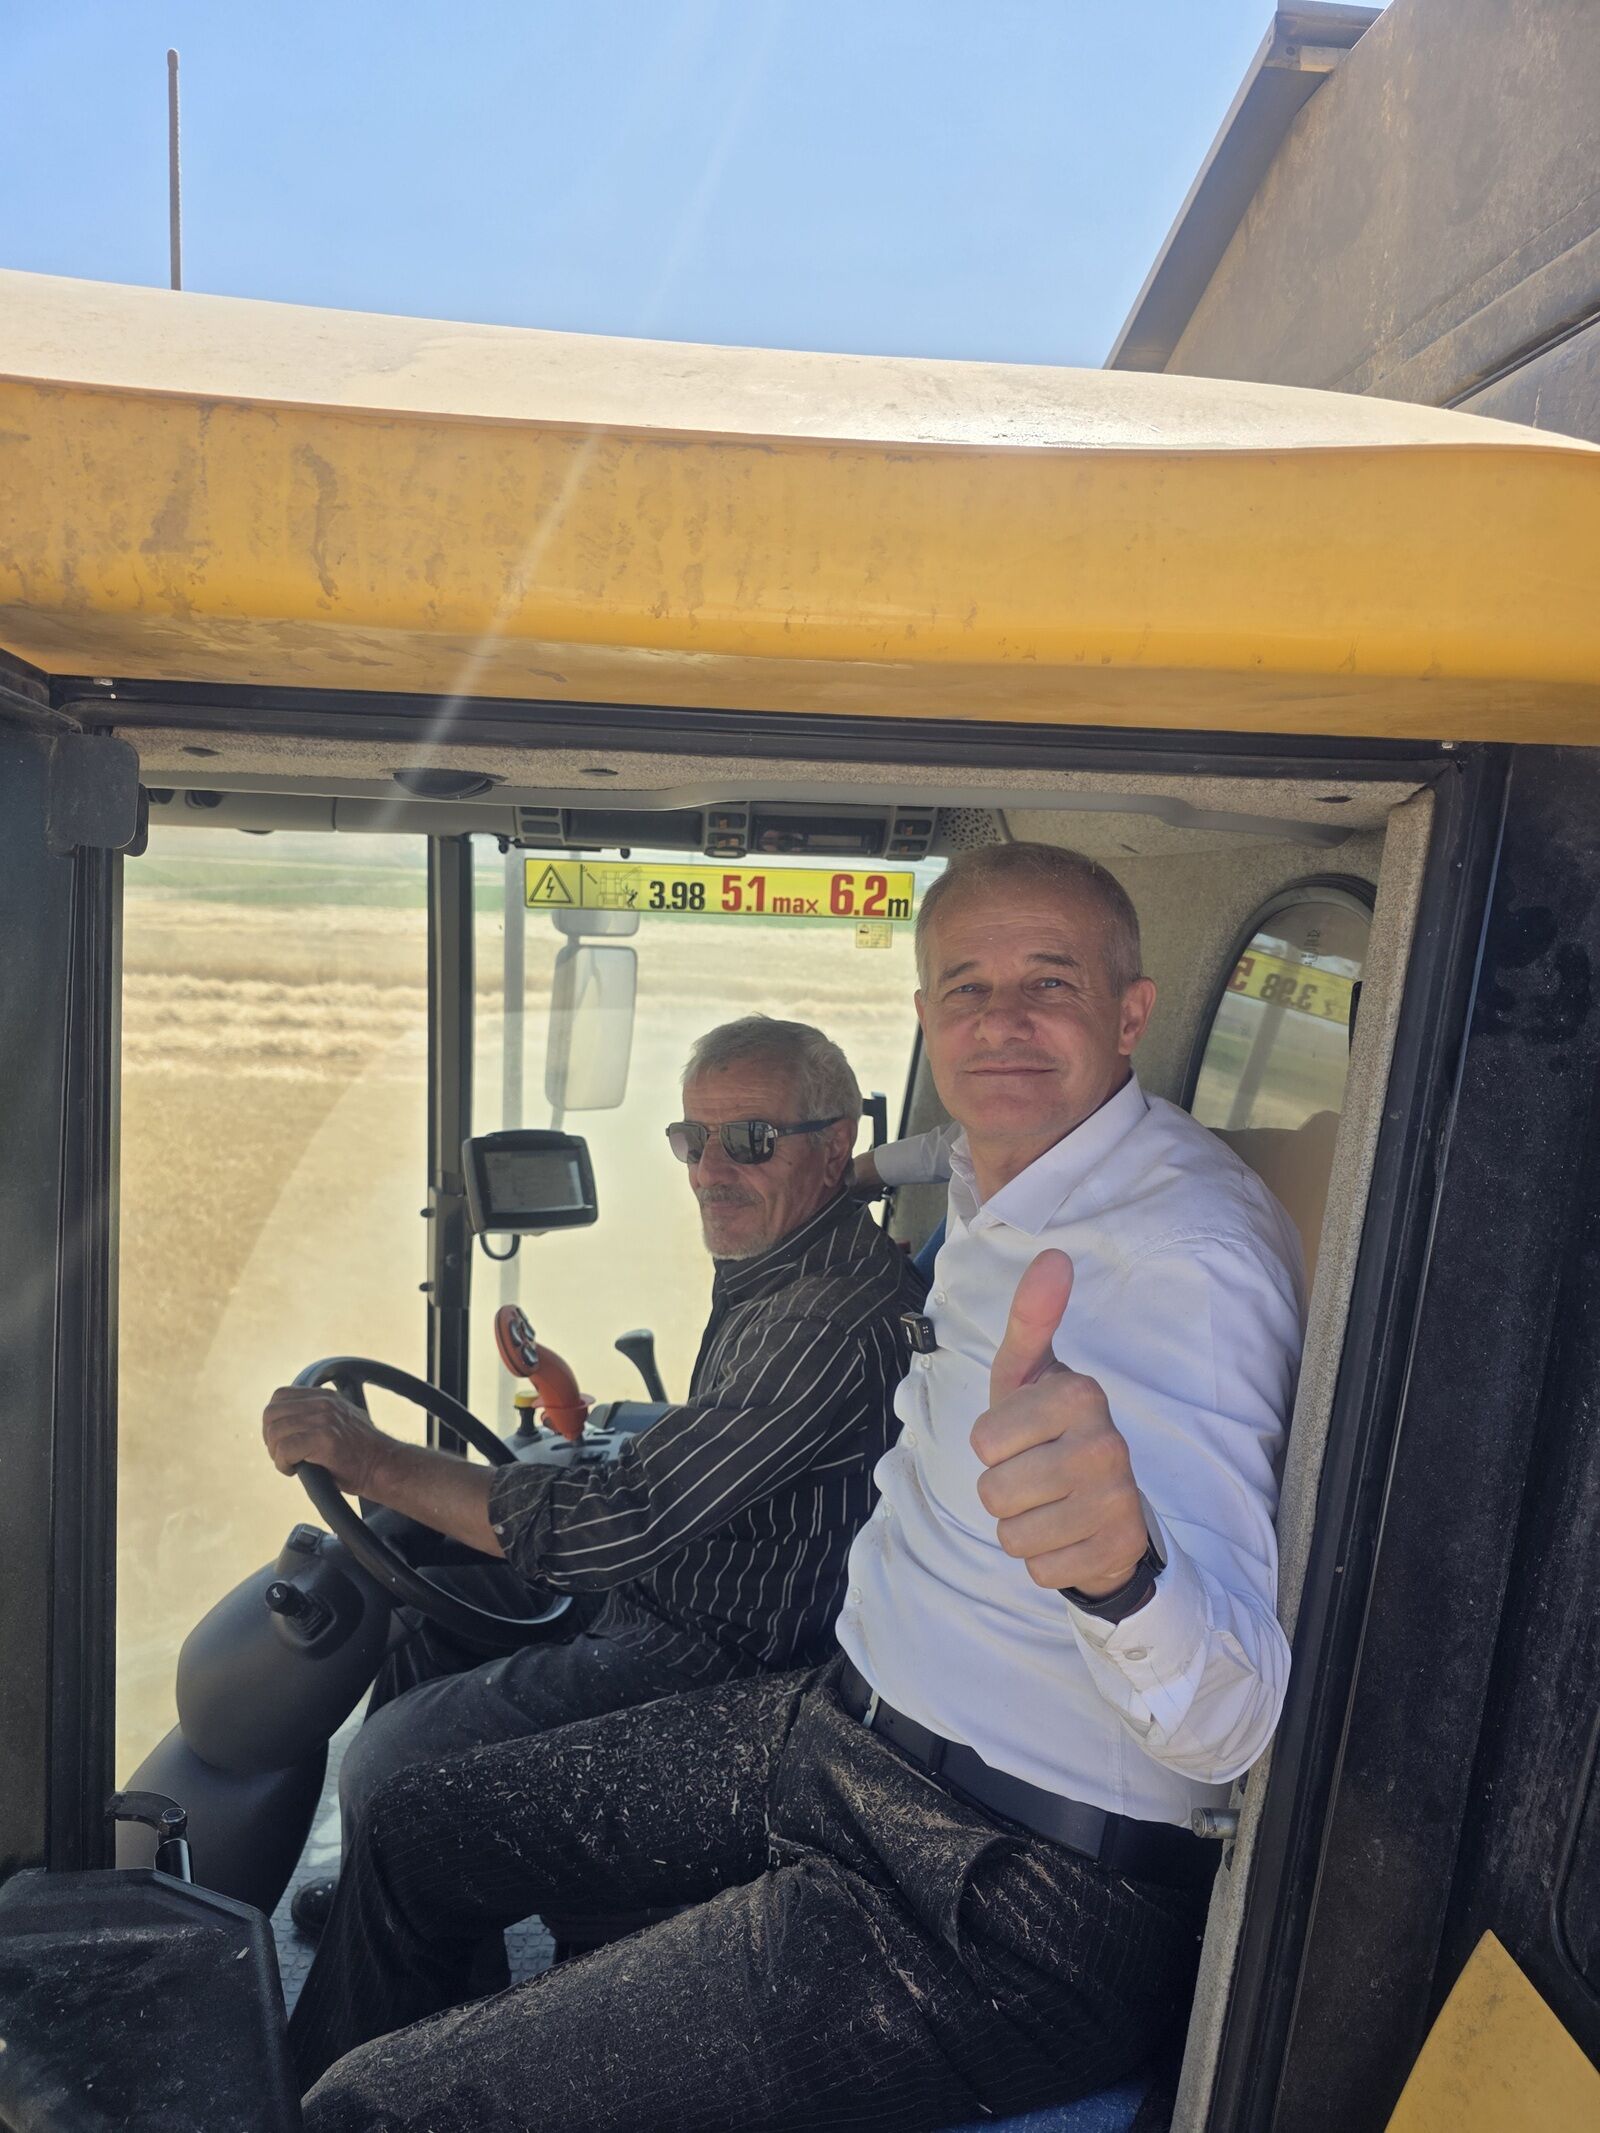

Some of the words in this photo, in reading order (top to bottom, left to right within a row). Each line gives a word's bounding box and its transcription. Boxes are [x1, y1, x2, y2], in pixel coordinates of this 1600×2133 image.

[649, 881, 706, 911] 3.98
[721, 874, 767, 913] 5.1
[772, 897, 819, 916] max
